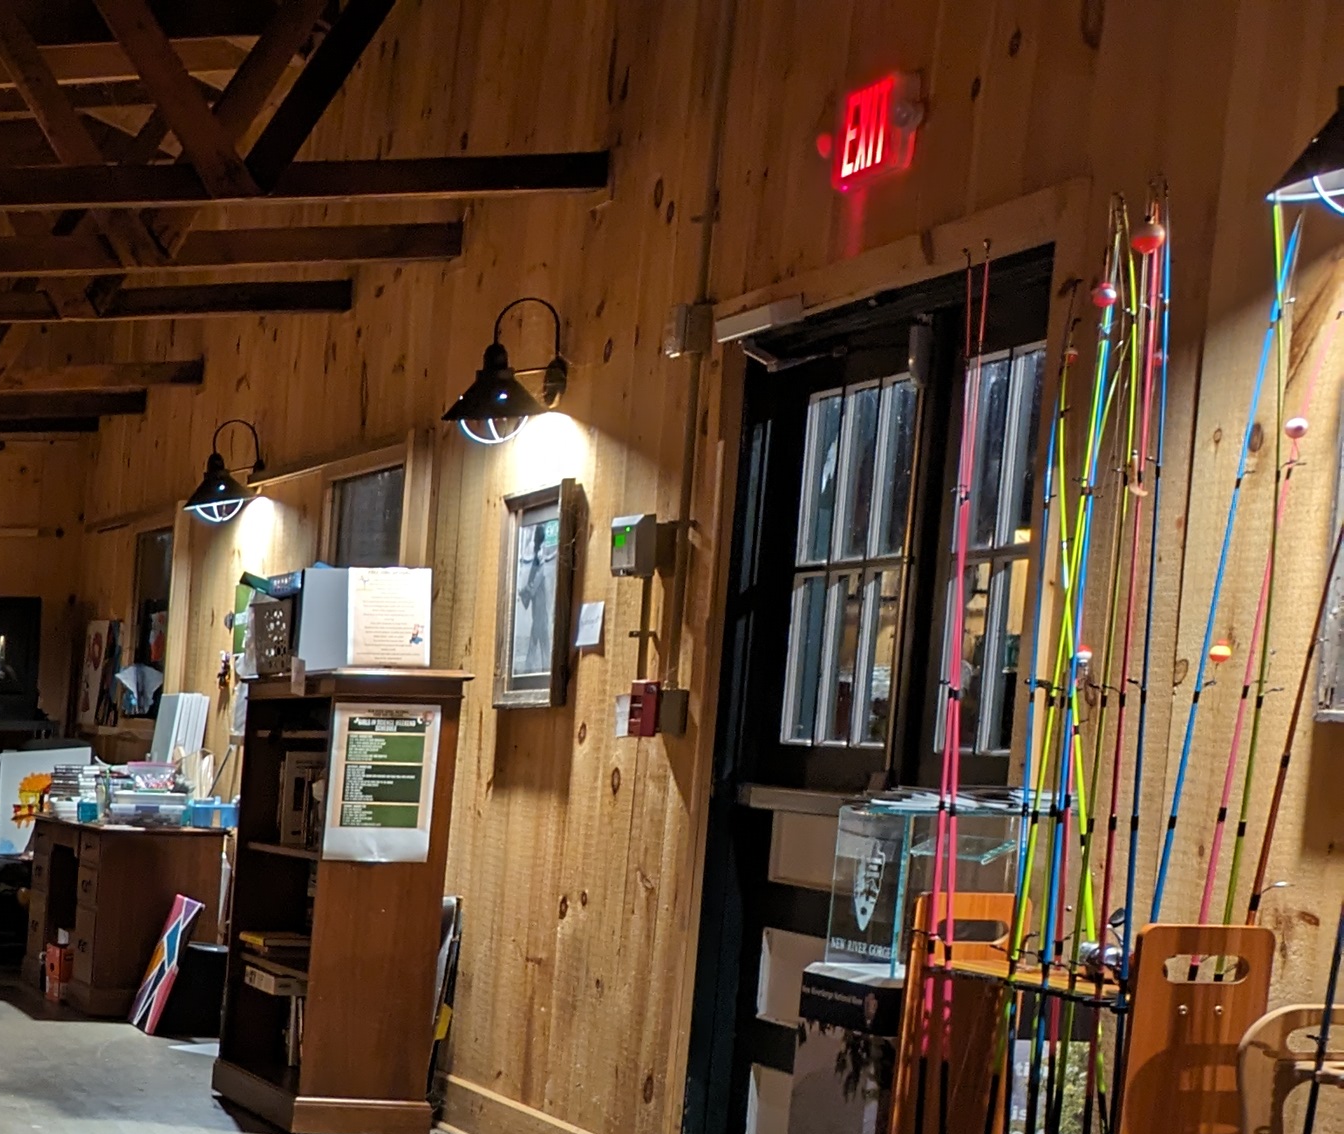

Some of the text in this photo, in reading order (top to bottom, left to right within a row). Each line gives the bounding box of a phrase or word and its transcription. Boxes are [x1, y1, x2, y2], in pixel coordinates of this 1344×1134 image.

[841, 79, 892, 178] EXIT
[830, 937, 892, 959] NEW RIVER GORGE
